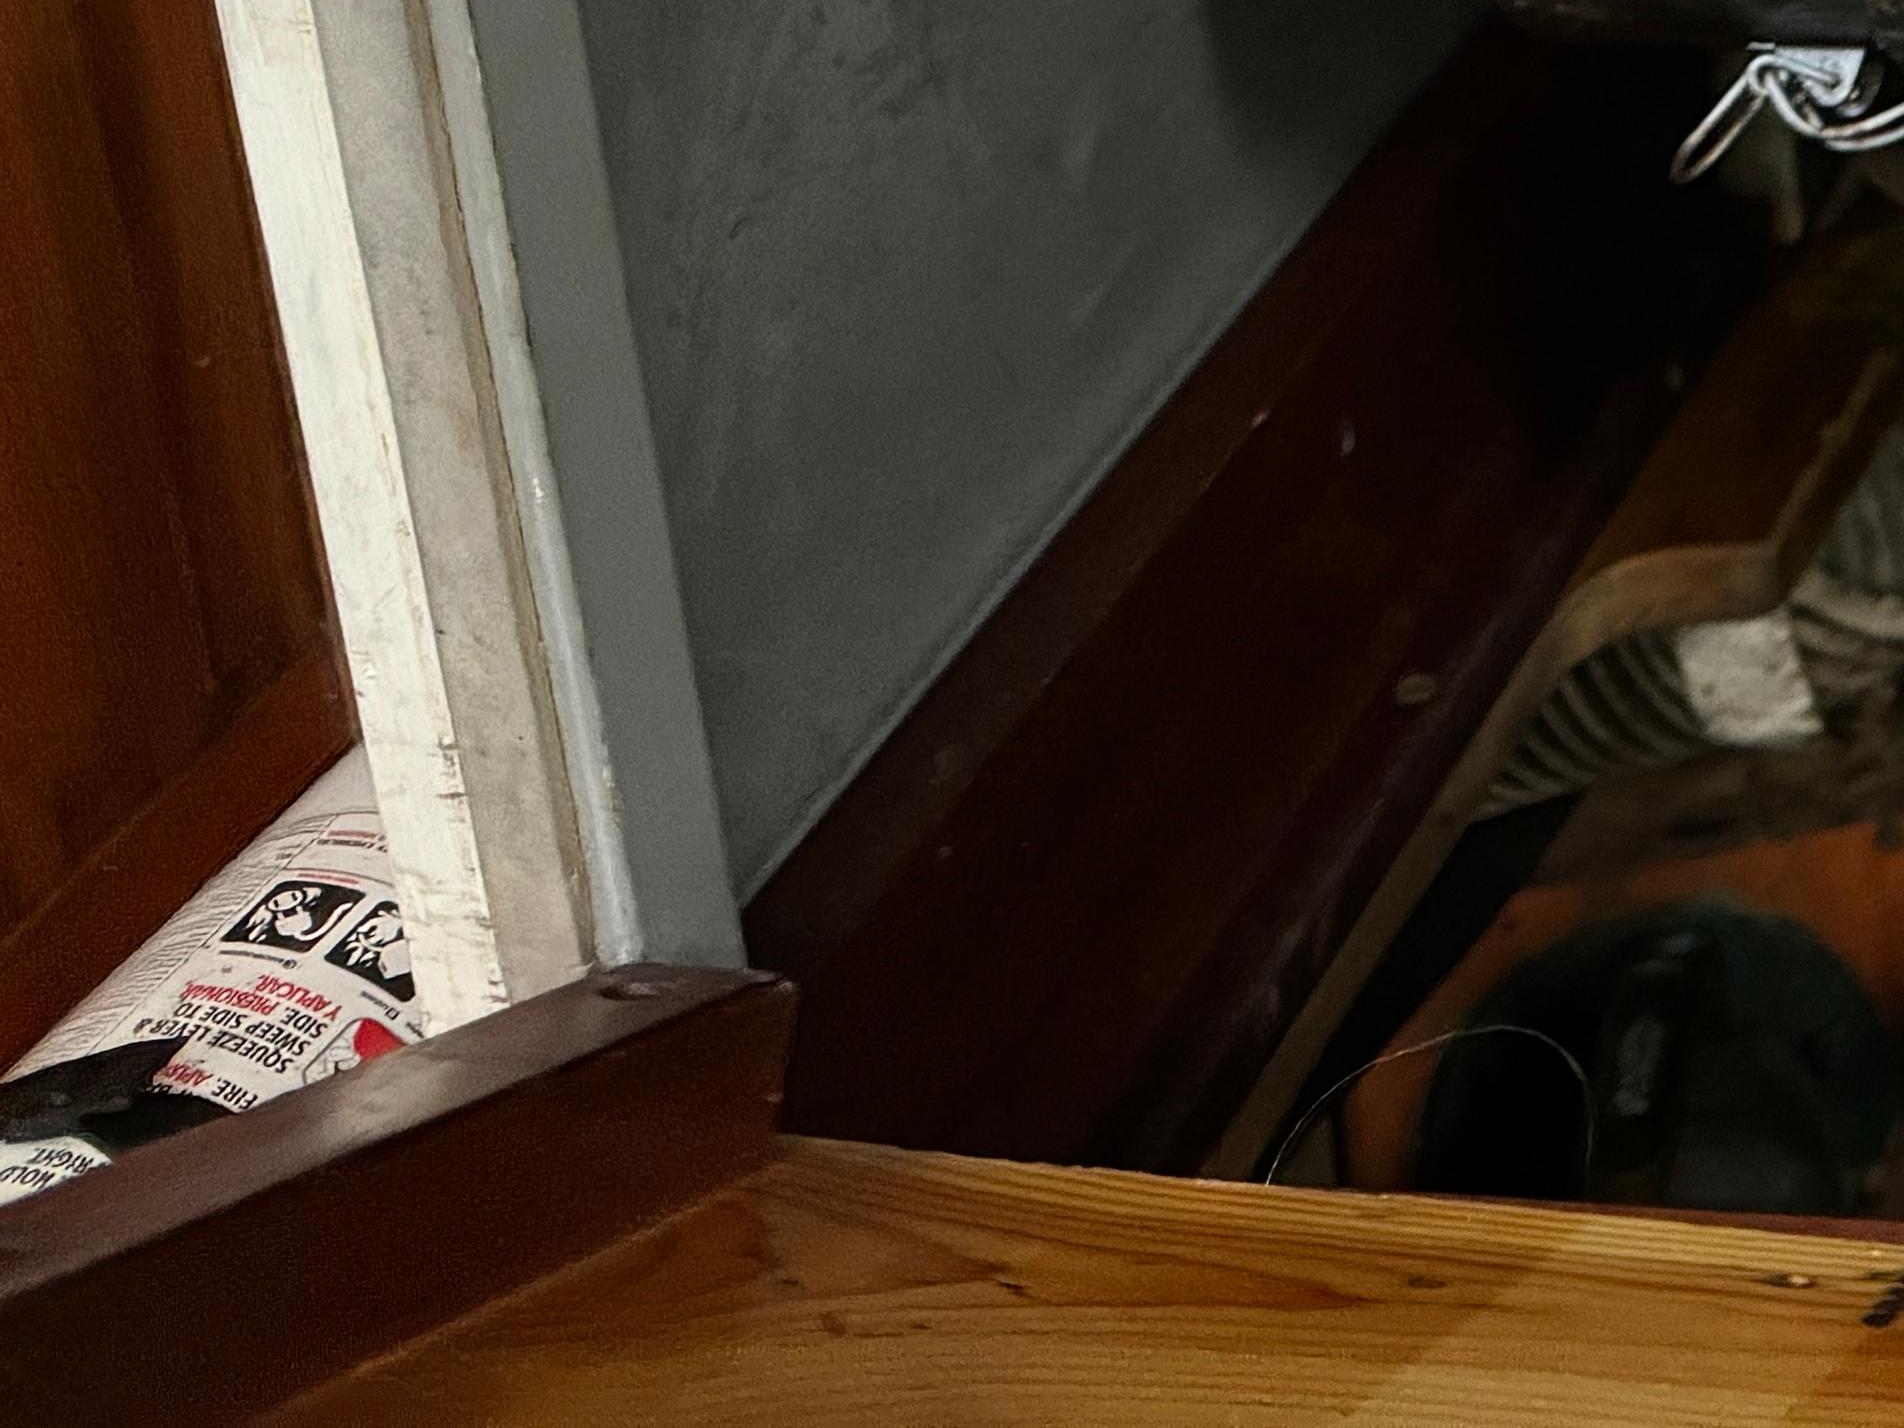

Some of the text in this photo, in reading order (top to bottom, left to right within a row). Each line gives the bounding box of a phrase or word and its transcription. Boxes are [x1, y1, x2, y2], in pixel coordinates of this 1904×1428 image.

[173, 1002, 310, 1056] SWEEP SIDE TO
[279, 1007, 327, 1039] SIDE.
[323, 1005, 342, 1021] Y
[149, 1018, 210, 1042] LEVER
[207, 1029, 293, 1074] SQUEEZE
[211, 1078, 258, 1110] FIRE.
